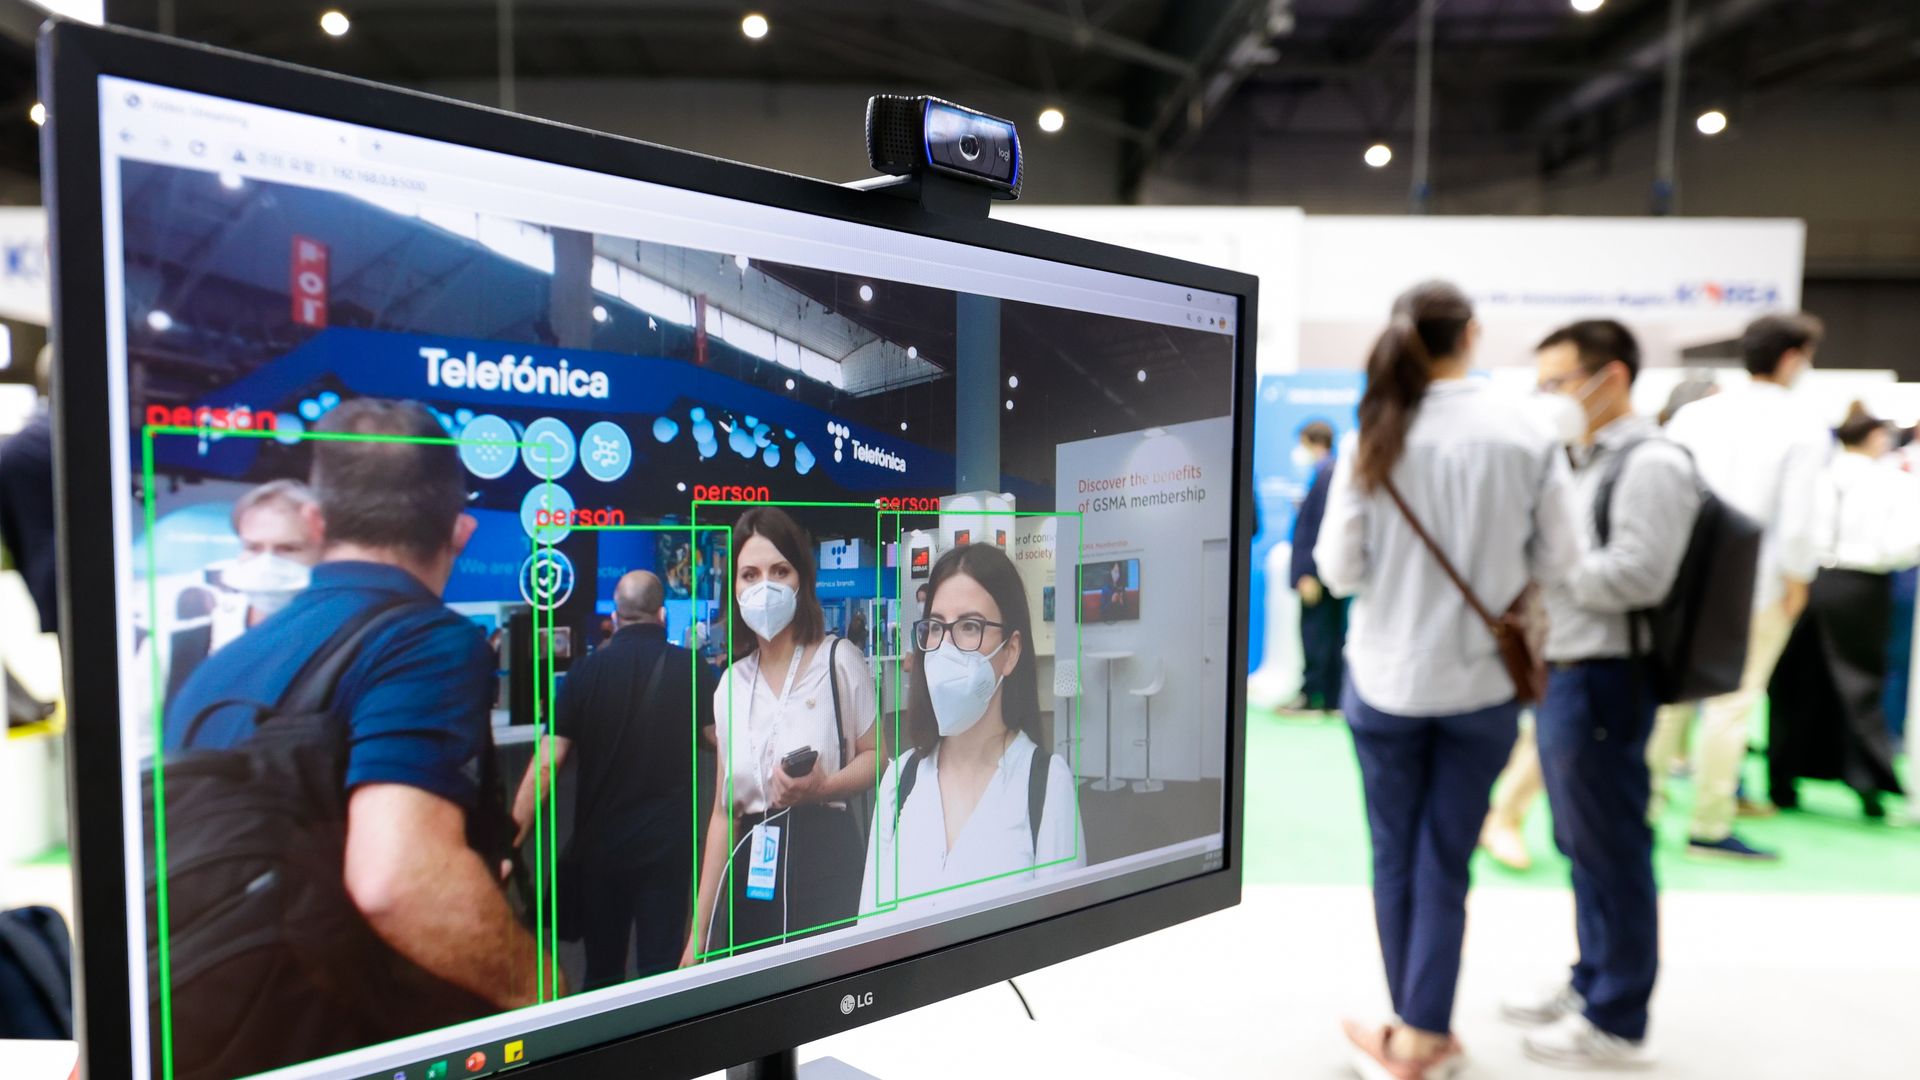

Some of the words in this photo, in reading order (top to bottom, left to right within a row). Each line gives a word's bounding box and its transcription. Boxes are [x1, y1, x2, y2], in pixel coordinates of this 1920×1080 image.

[419, 347, 609, 398] Telefónica
[146, 405, 277, 430] person
[852, 439, 906, 472] Telefónica
[693, 484, 769, 502] person
[1078, 475, 1126, 494] Discover
[1130, 472, 1147, 487] the
[879, 496, 941, 511] person
[1078, 498, 1089, 513] of
[1093, 495, 1127, 512] GSMA
[1131, 485, 1206, 508] membership
[535, 508, 625, 527] person
[1026, 547, 1052, 560] society
[857, 991, 873, 1008] LG
